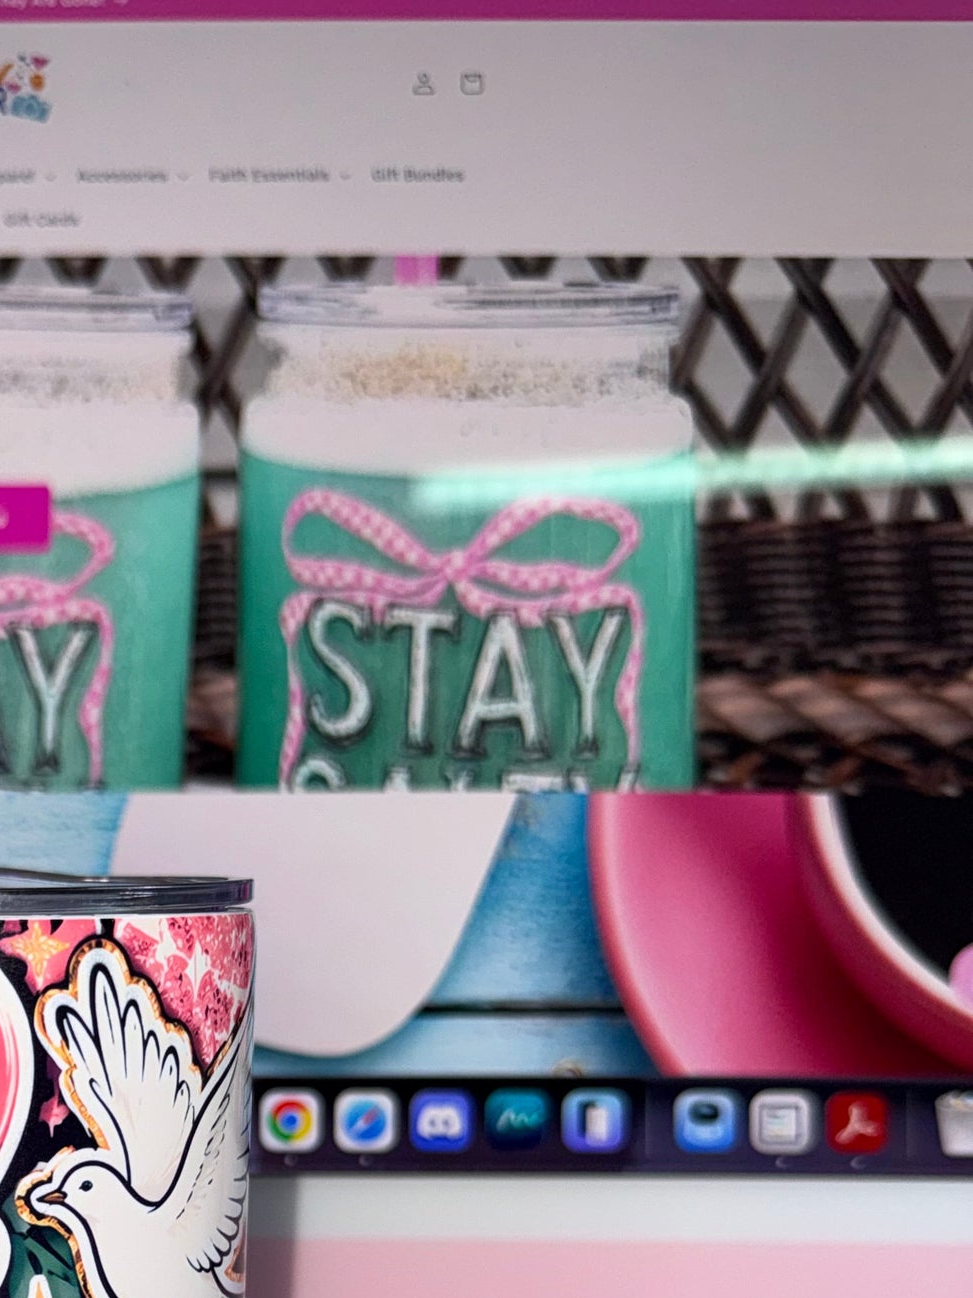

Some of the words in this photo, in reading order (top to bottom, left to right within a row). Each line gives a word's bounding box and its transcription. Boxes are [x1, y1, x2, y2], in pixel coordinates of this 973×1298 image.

[207, 167, 248, 184] Faith
[251, 167, 330, 184] Essentials
[371, 166, 400, 184] Gift
[403, 166, 465, 184] Bundles
[2, 211, 30, 228] Gift
[308, 599, 629, 758] STAY
